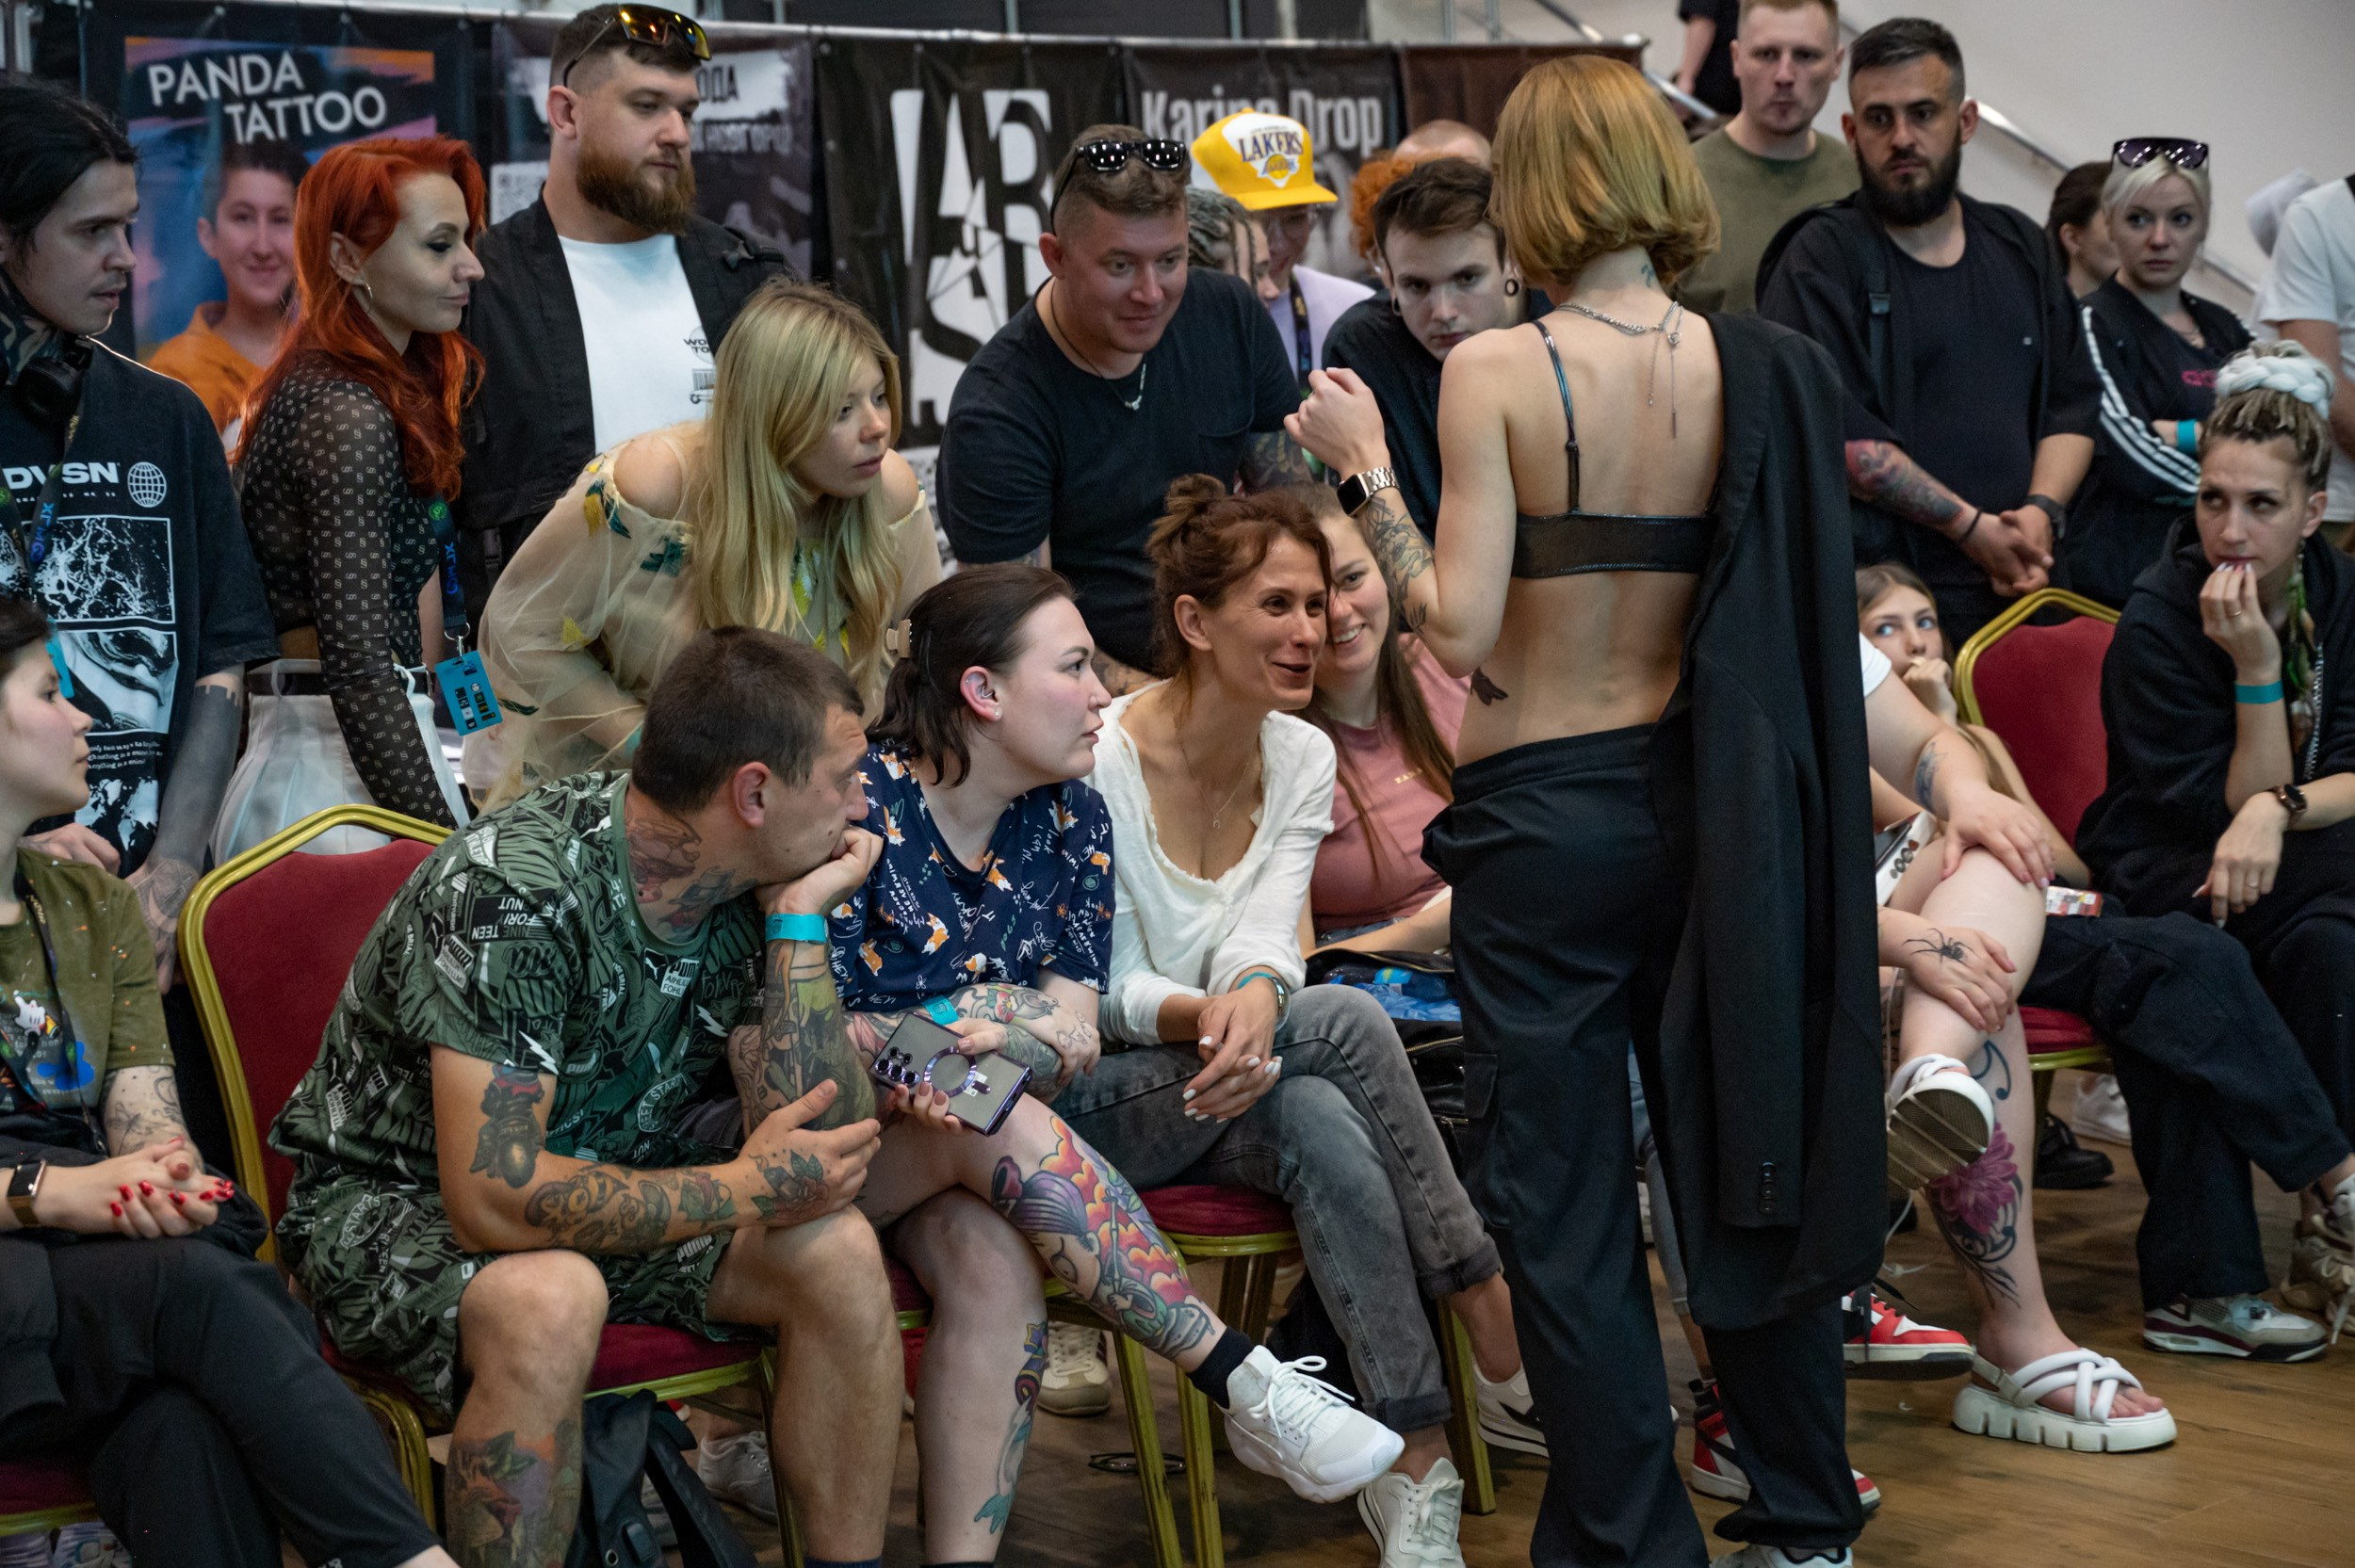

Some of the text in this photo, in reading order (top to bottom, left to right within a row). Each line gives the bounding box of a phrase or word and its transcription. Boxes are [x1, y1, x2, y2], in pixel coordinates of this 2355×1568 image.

[147, 50, 305, 106] PANDA
[223, 86, 386, 145] TATTOO
[1141, 85, 1384, 158] Kari Drop
[1238, 132, 1304, 163] LAKERS
[471, 925, 499, 940] TEEN
